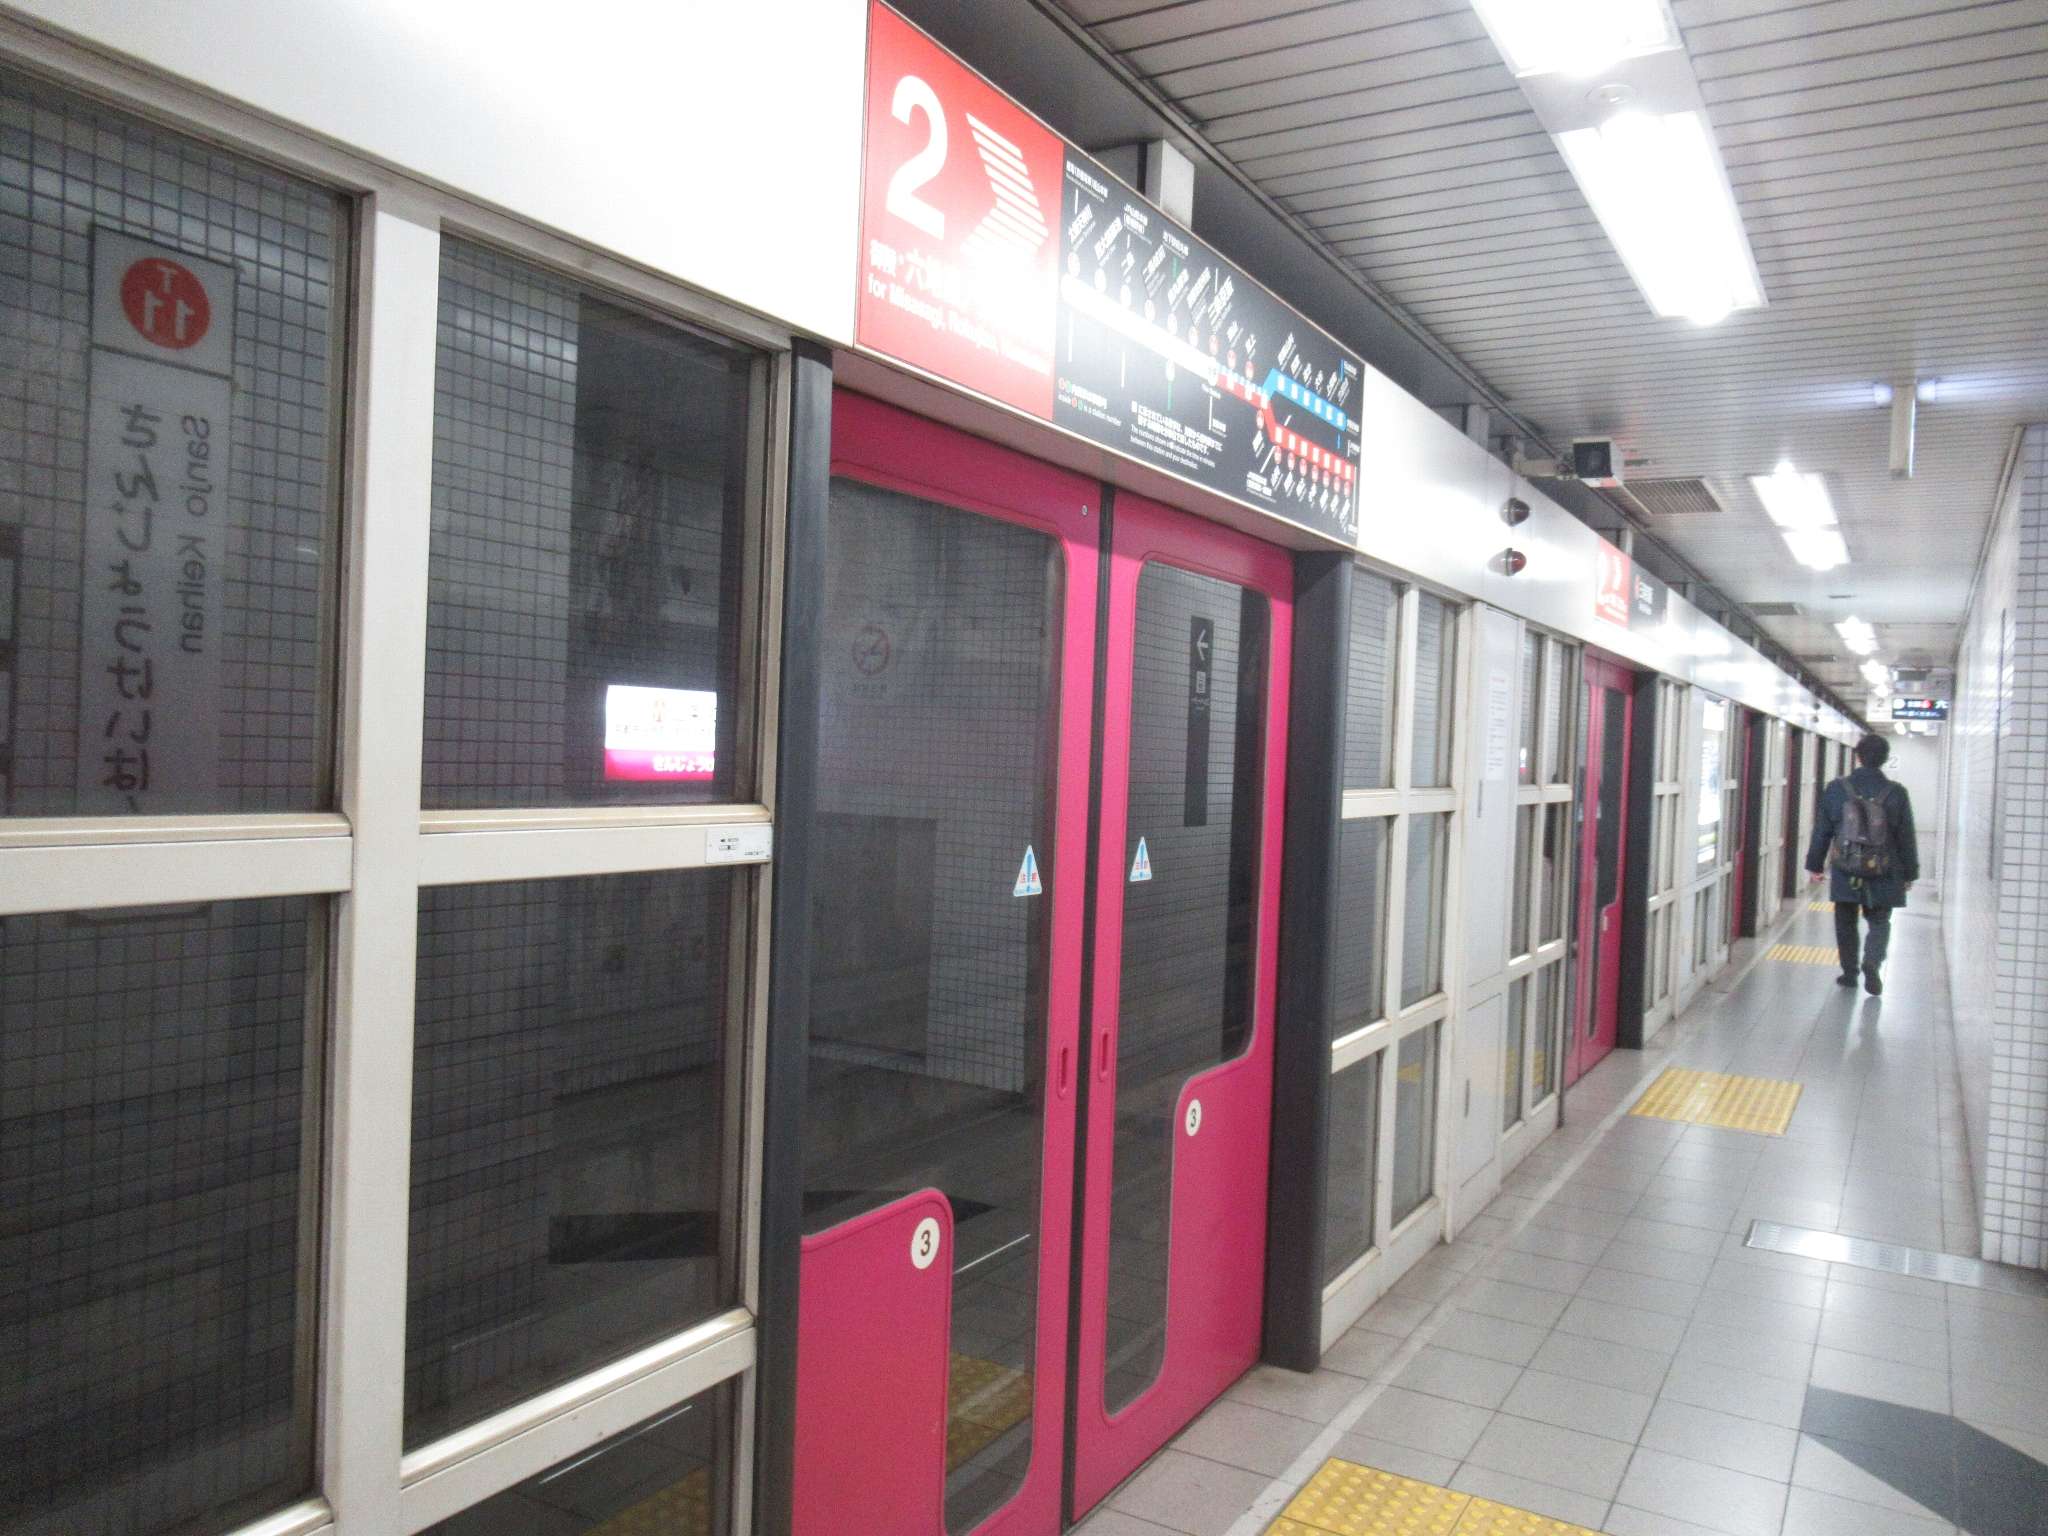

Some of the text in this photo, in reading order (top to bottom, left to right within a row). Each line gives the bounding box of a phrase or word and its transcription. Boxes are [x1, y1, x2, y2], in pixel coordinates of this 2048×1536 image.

[885, 74, 949, 241] 2
[867, 273, 887, 299] for
[1189, 1108, 1198, 1129] 3
[919, 1230, 932, 1257] 3
